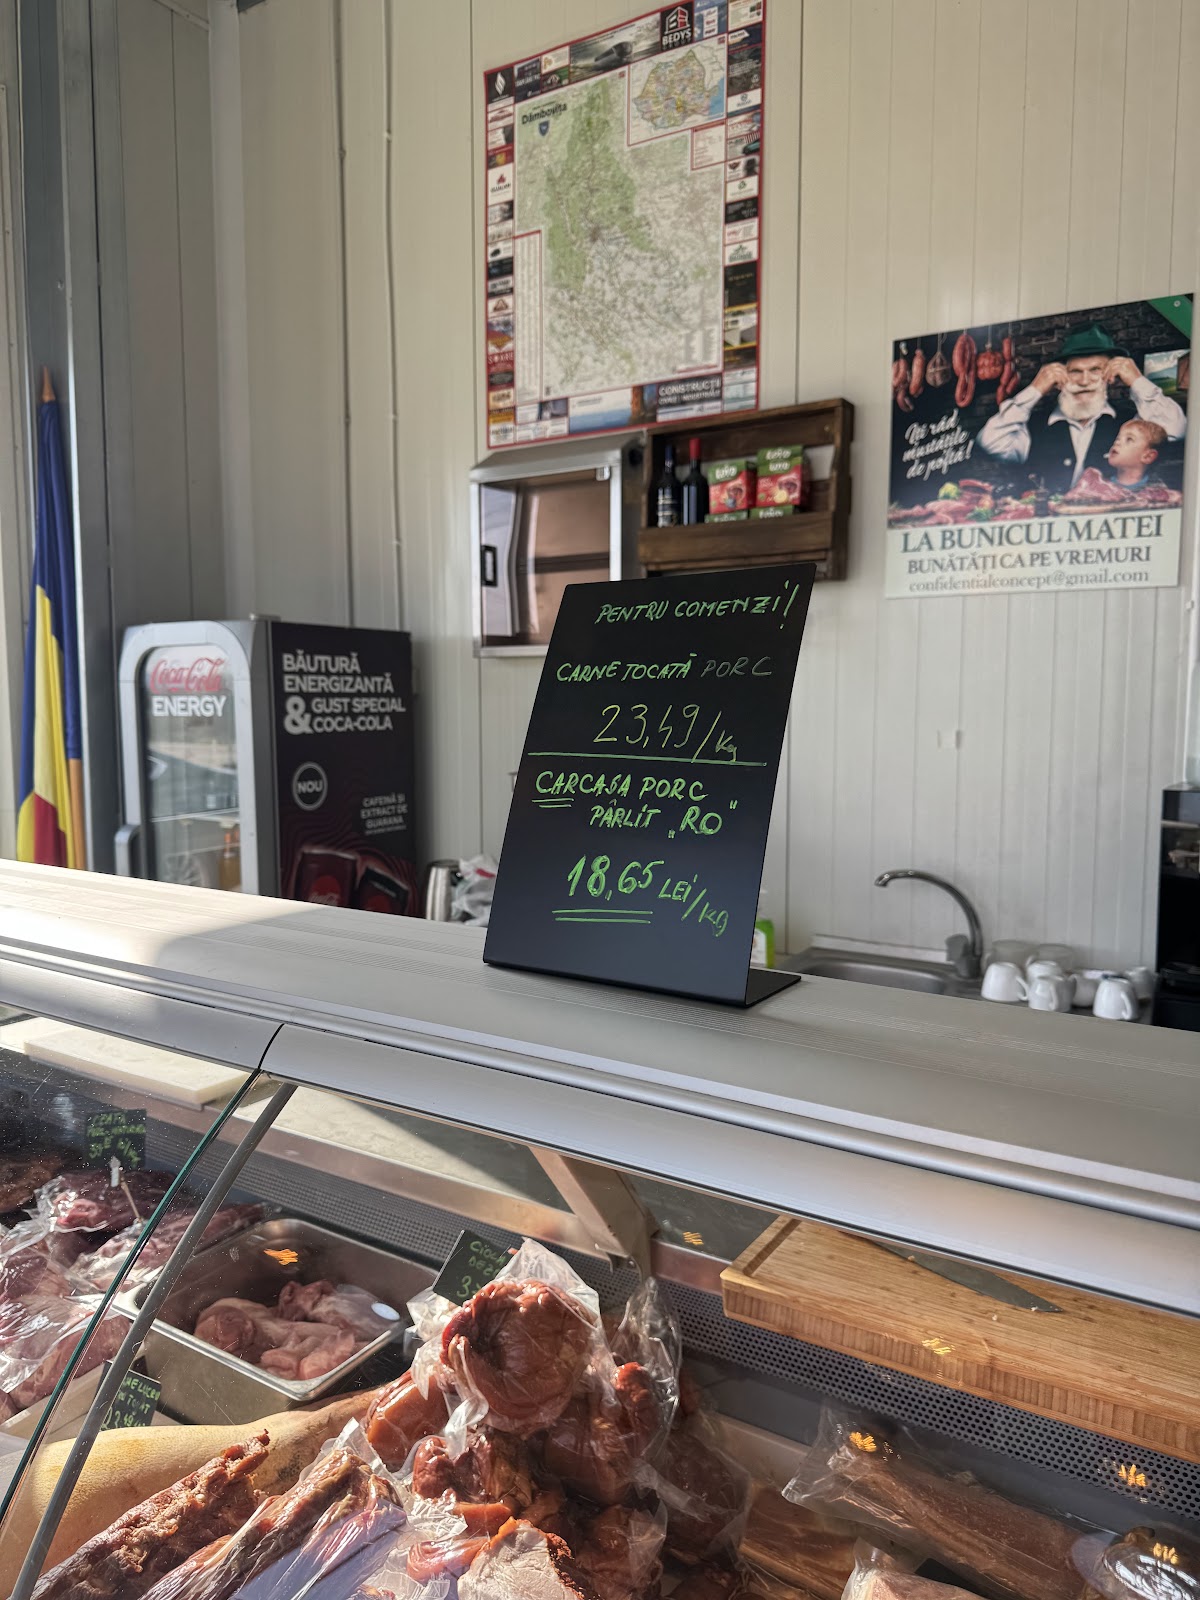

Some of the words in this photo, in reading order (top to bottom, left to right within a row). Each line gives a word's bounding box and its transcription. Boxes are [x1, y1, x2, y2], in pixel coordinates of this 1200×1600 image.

[661, 28, 692, 47] BEDYS
[901, 530, 935, 553] LA
[940, 521, 1062, 551] BUNICUL
[1067, 513, 1164, 543] MATEI
[907, 551, 998, 575] BUNĂTĂȚI
[999, 553, 1026, 569] CA
[1029, 550, 1052, 568] PE
[1054, 544, 1152, 566] VREMURI
[908, 567, 1150, 593] confidentialconcept@gmail.com
[594, 600, 670, 625] PENTRU
[282, 648, 362, 674] BĂUTURĂ
[556, 660, 622, 683] CARNE
[700, 656, 773, 679] PORC
[150, 656, 226, 695] Coca-Cola
[283, 672, 395, 694] ENERGIZANTĂ
[152, 694, 227, 717] ENERGY
[284, 694, 314, 736] &
[311, 696, 351, 713] GUST
[351, 697, 406, 713] SPECIAL
[312, 714, 394, 733] COCA-COLA
[297, 780, 323, 795] NOU
[535, 770, 632, 798] CARCASA
[638, 776, 709, 802] PORC
[361, 804, 395, 819] EXTRACT
[397, 803, 408, 814] DE
[566, 854, 665, 901] 18,65
